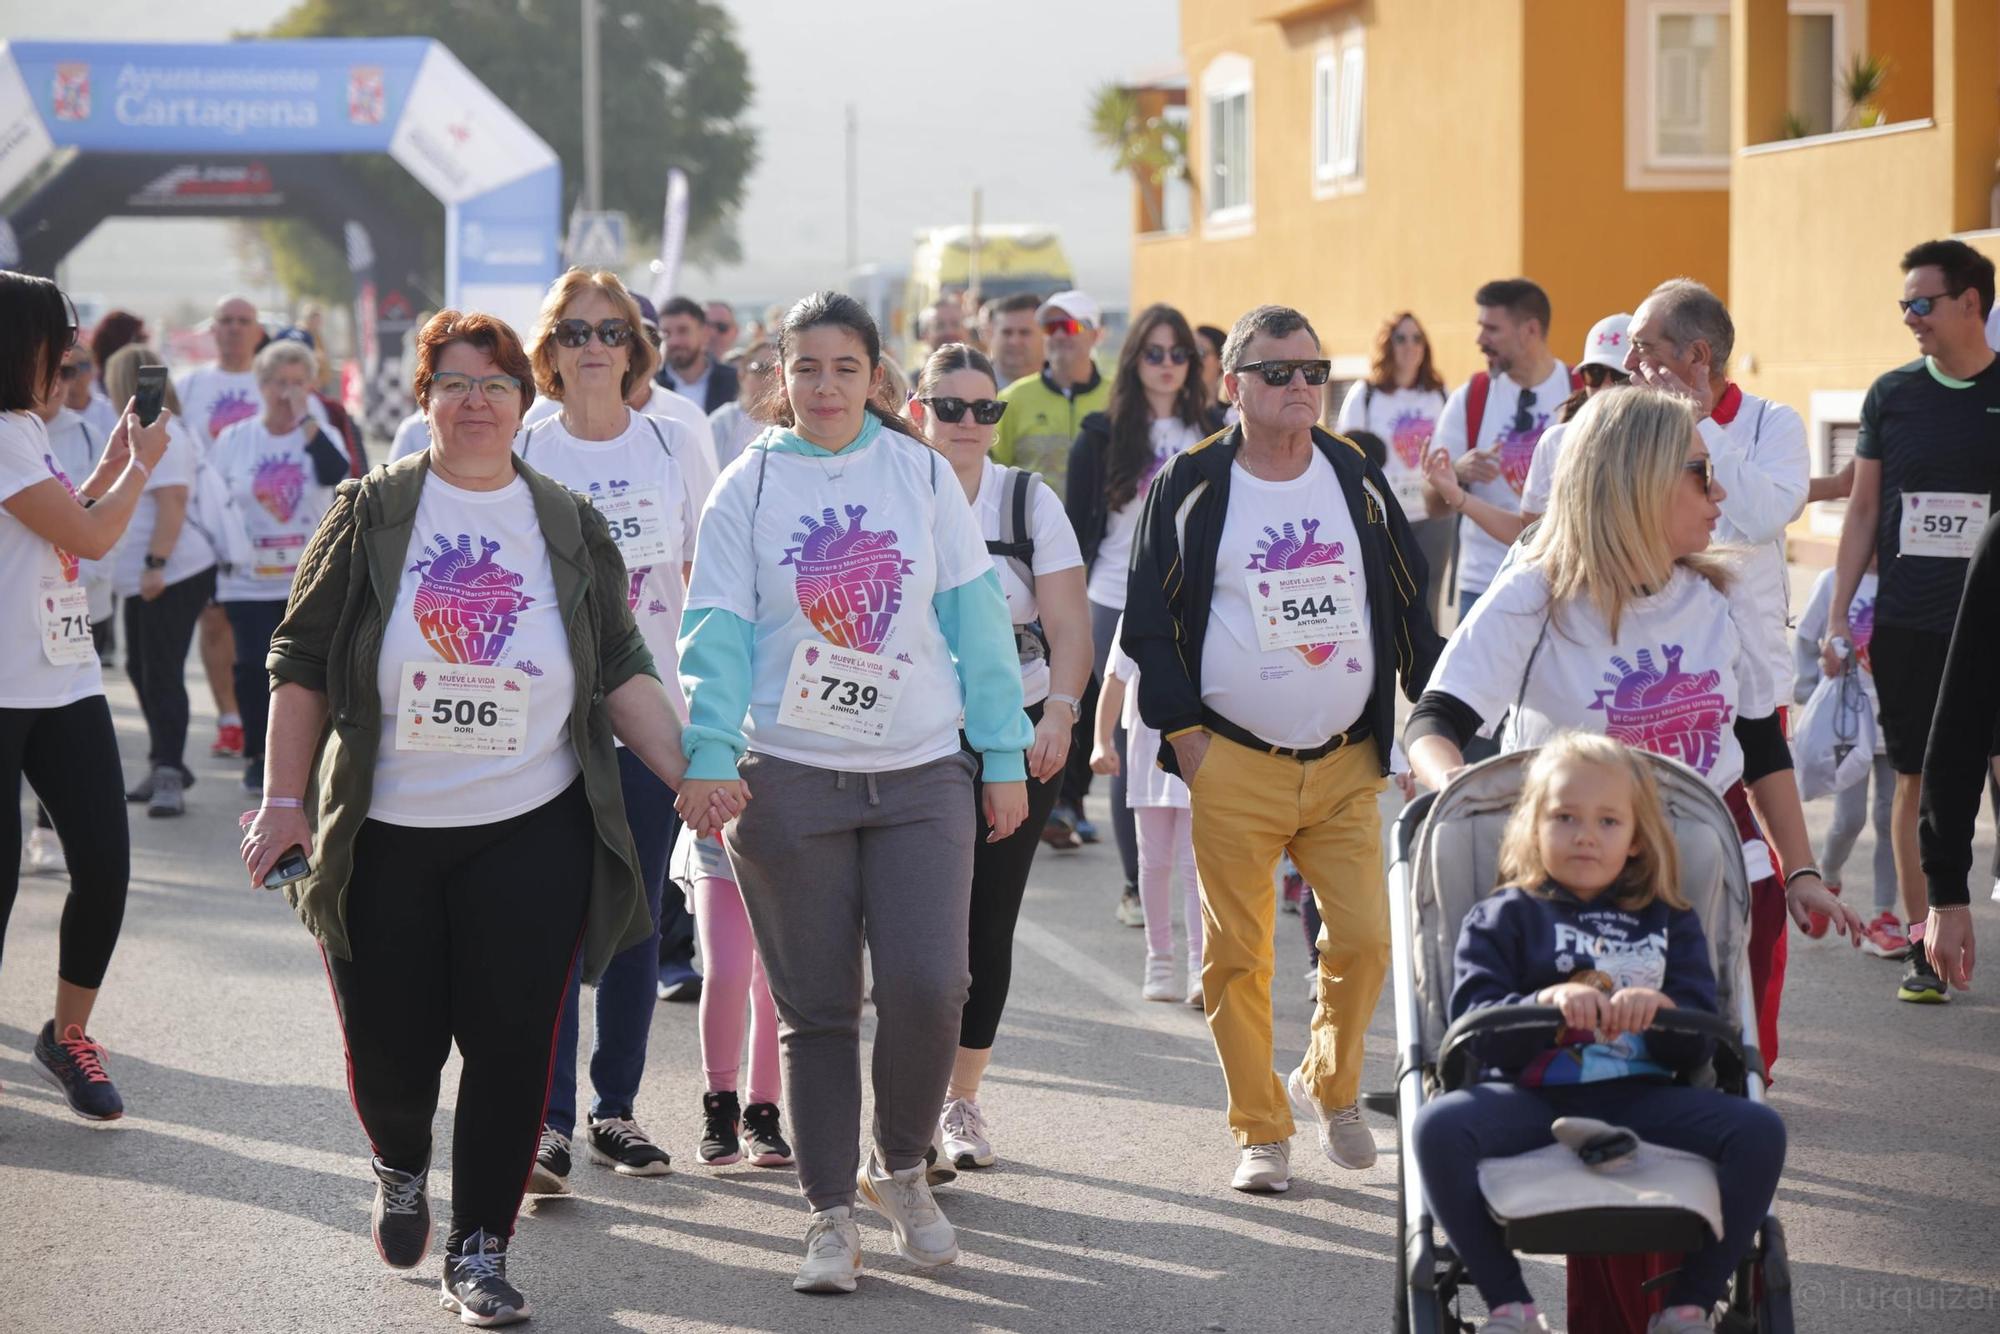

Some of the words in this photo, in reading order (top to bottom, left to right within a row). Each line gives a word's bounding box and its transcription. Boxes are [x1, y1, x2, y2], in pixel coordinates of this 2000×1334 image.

[116, 63, 320, 95] Ayuntamiento
[115, 91, 319, 135] Cartagena
[1923, 515, 1968, 533] 597
[809, 564, 837, 572] Carrera
[843, 557, 870, 567] Marcha
[870, 553, 897, 561] Urbana
[433, 584, 461, 593] Carrera
[465, 589, 491, 597] Marcha
[1279, 578, 1301, 587] MUEVE
[1302, 577, 1310, 585] LA
[1310, 576, 1326, 584] VIDA
[810, 580, 902, 632] MUEVE
[1282, 595, 1337, 621] 544
[419, 609, 518, 640] MUEVE
[823, 613, 893, 650] VIDA
[1297, 618, 1327, 627] ANTONIO
[427, 632, 506, 664] VIDA
[831, 654, 857, 665] MUEVE
[867, 662, 884, 672] VIDA
[439, 675, 465, 683] MUEVE
[467, 676, 477, 684] LA
[478, 677, 495, 685] VIDA
[820, 675, 879, 711] 739
[432, 699, 498, 727] 506
[830, 704, 859, 716] AINHOA
[1622, 712, 1654, 722] Carrera
[1661, 705, 1690, 717] Marcha
[1692, 700, 1720, 709] Urbana
[454, 726, 474, 734] DORI
[1603, 912, 1616, 920] the
[1554, 922, 1668, 960] FROZEN
